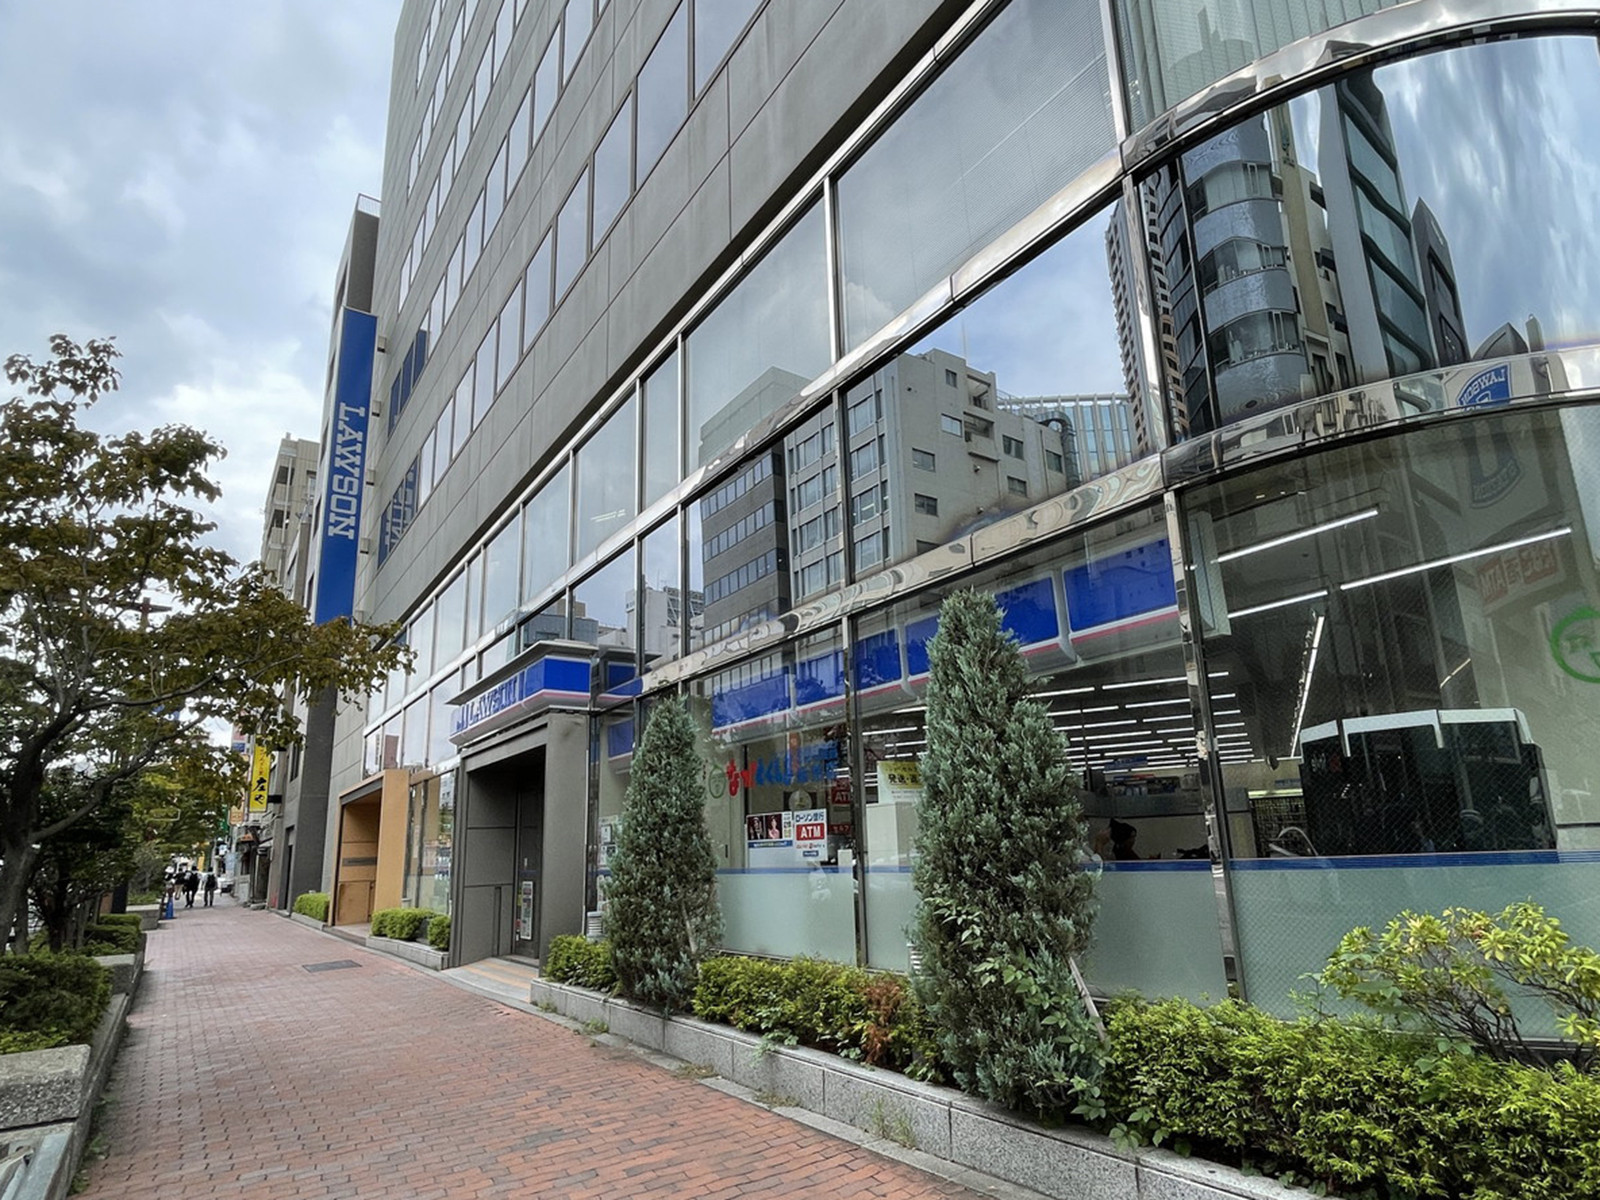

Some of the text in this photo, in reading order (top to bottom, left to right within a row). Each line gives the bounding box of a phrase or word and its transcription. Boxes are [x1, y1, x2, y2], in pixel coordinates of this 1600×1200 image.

[328, 401, 366, 540] LAWSON
[468, 678, 519, 725] LAWSON
[252, 776, 267, 805] 庄や
[795, 811, 825, 823] ローソン銀行
[800, 825, 821, 839] ATM
